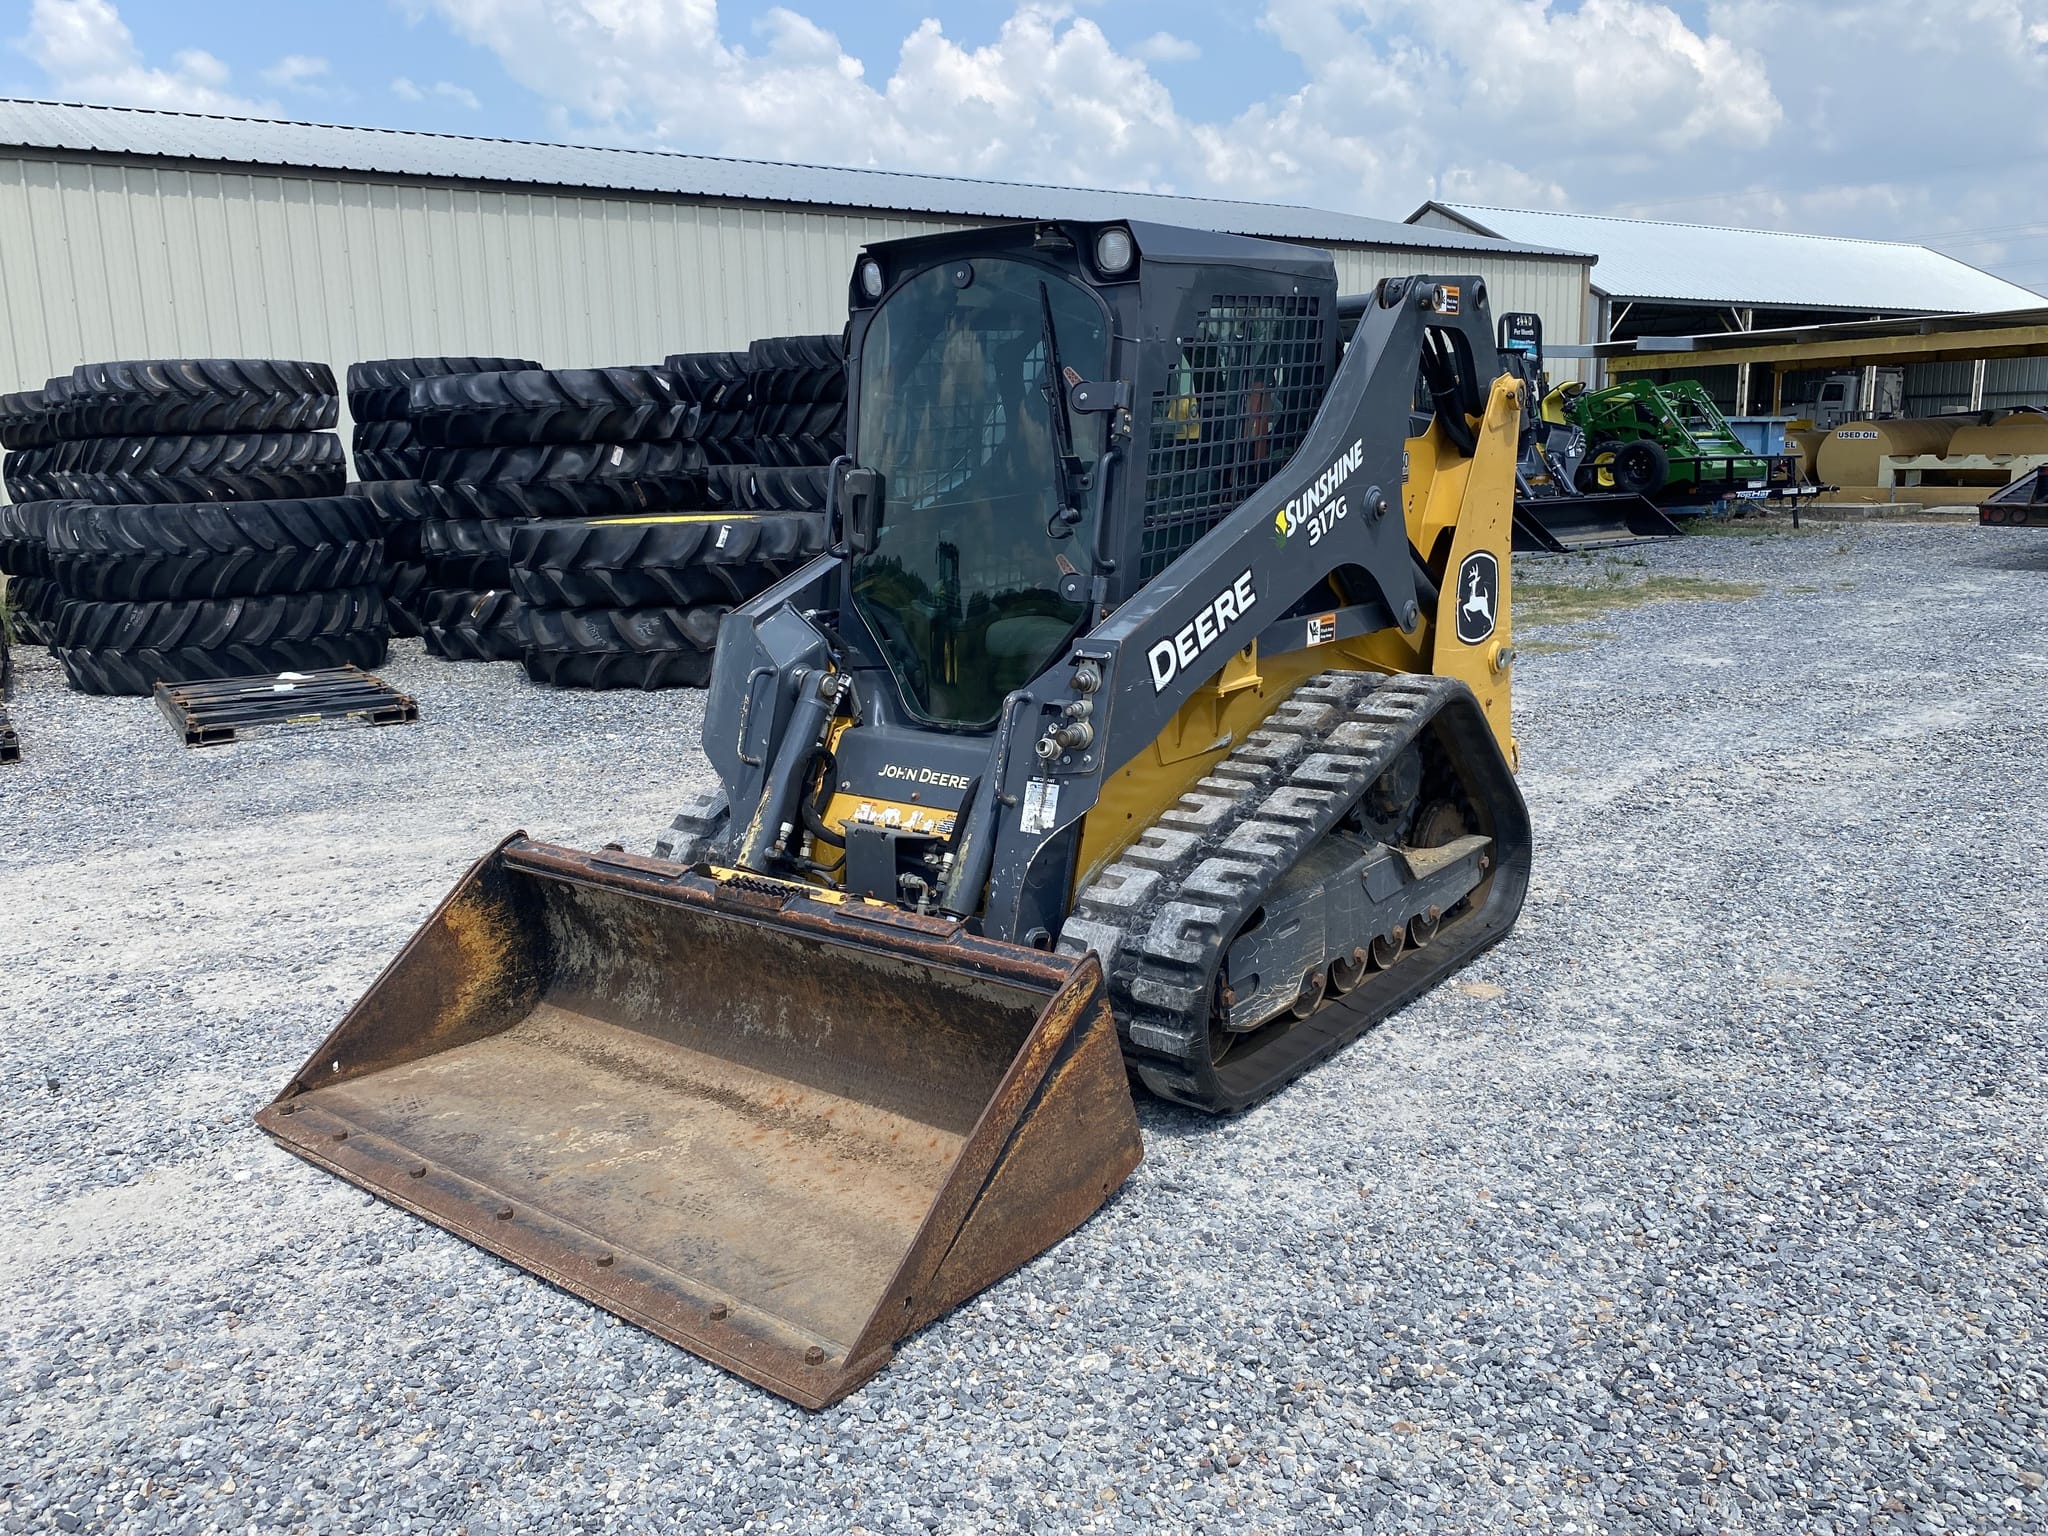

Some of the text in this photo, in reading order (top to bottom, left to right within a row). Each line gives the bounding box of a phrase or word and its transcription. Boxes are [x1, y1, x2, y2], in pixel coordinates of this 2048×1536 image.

[1838, 431, 1878, 439] USED OIL
[1286, 438, 1364, 538] SUNSHINE
[1306, 495, 1348, 547] 317G
[1147, 569, 1257, 693] DEERE
[878, 763, 970, 790] JOHN DEERE
